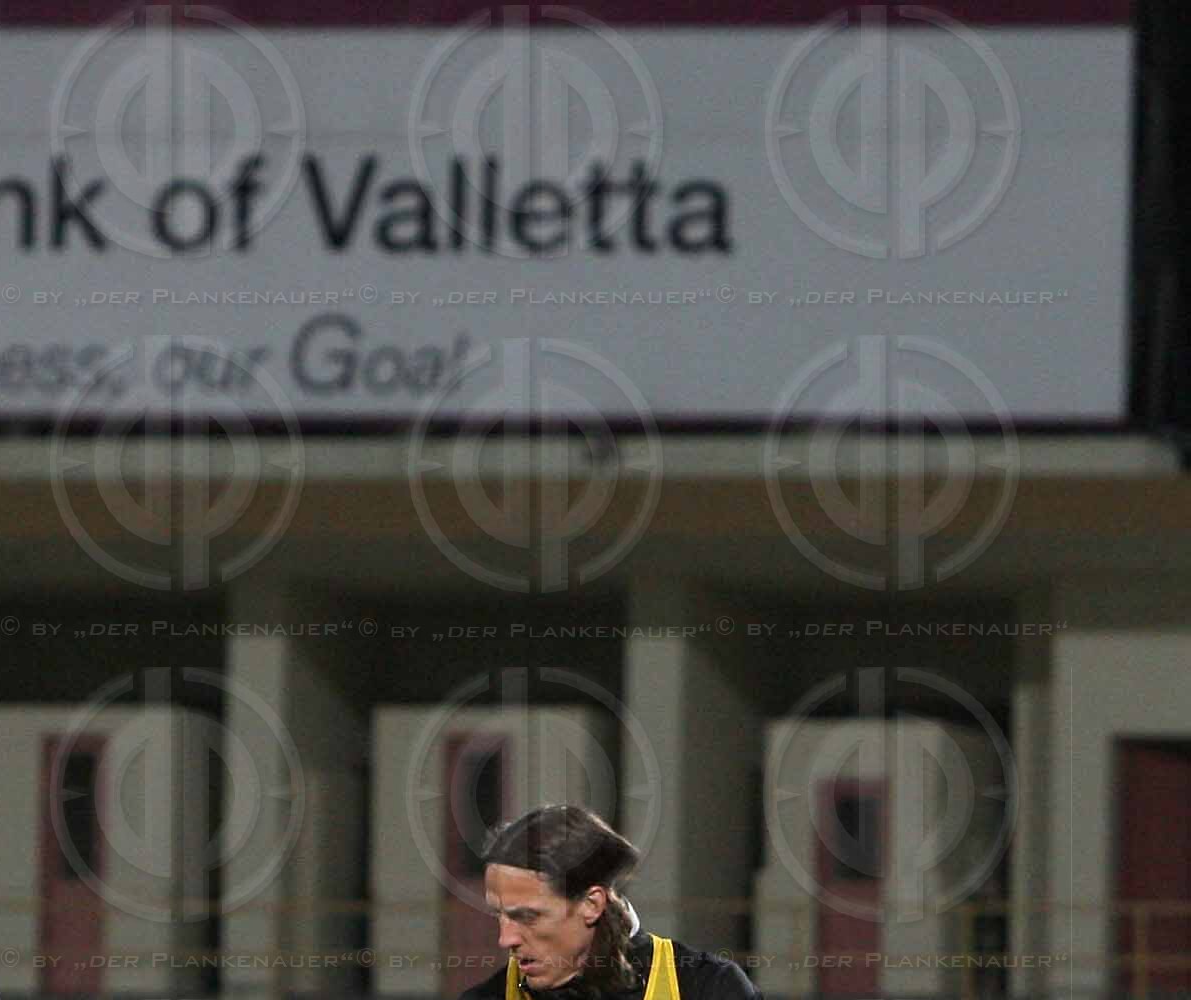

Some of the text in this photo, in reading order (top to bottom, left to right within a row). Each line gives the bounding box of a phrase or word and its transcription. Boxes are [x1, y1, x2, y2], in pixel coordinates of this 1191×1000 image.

[151, 152, 267, 252] of
[303, 152, 734, 254] Valletta
[153, 343, 268, 394] our
